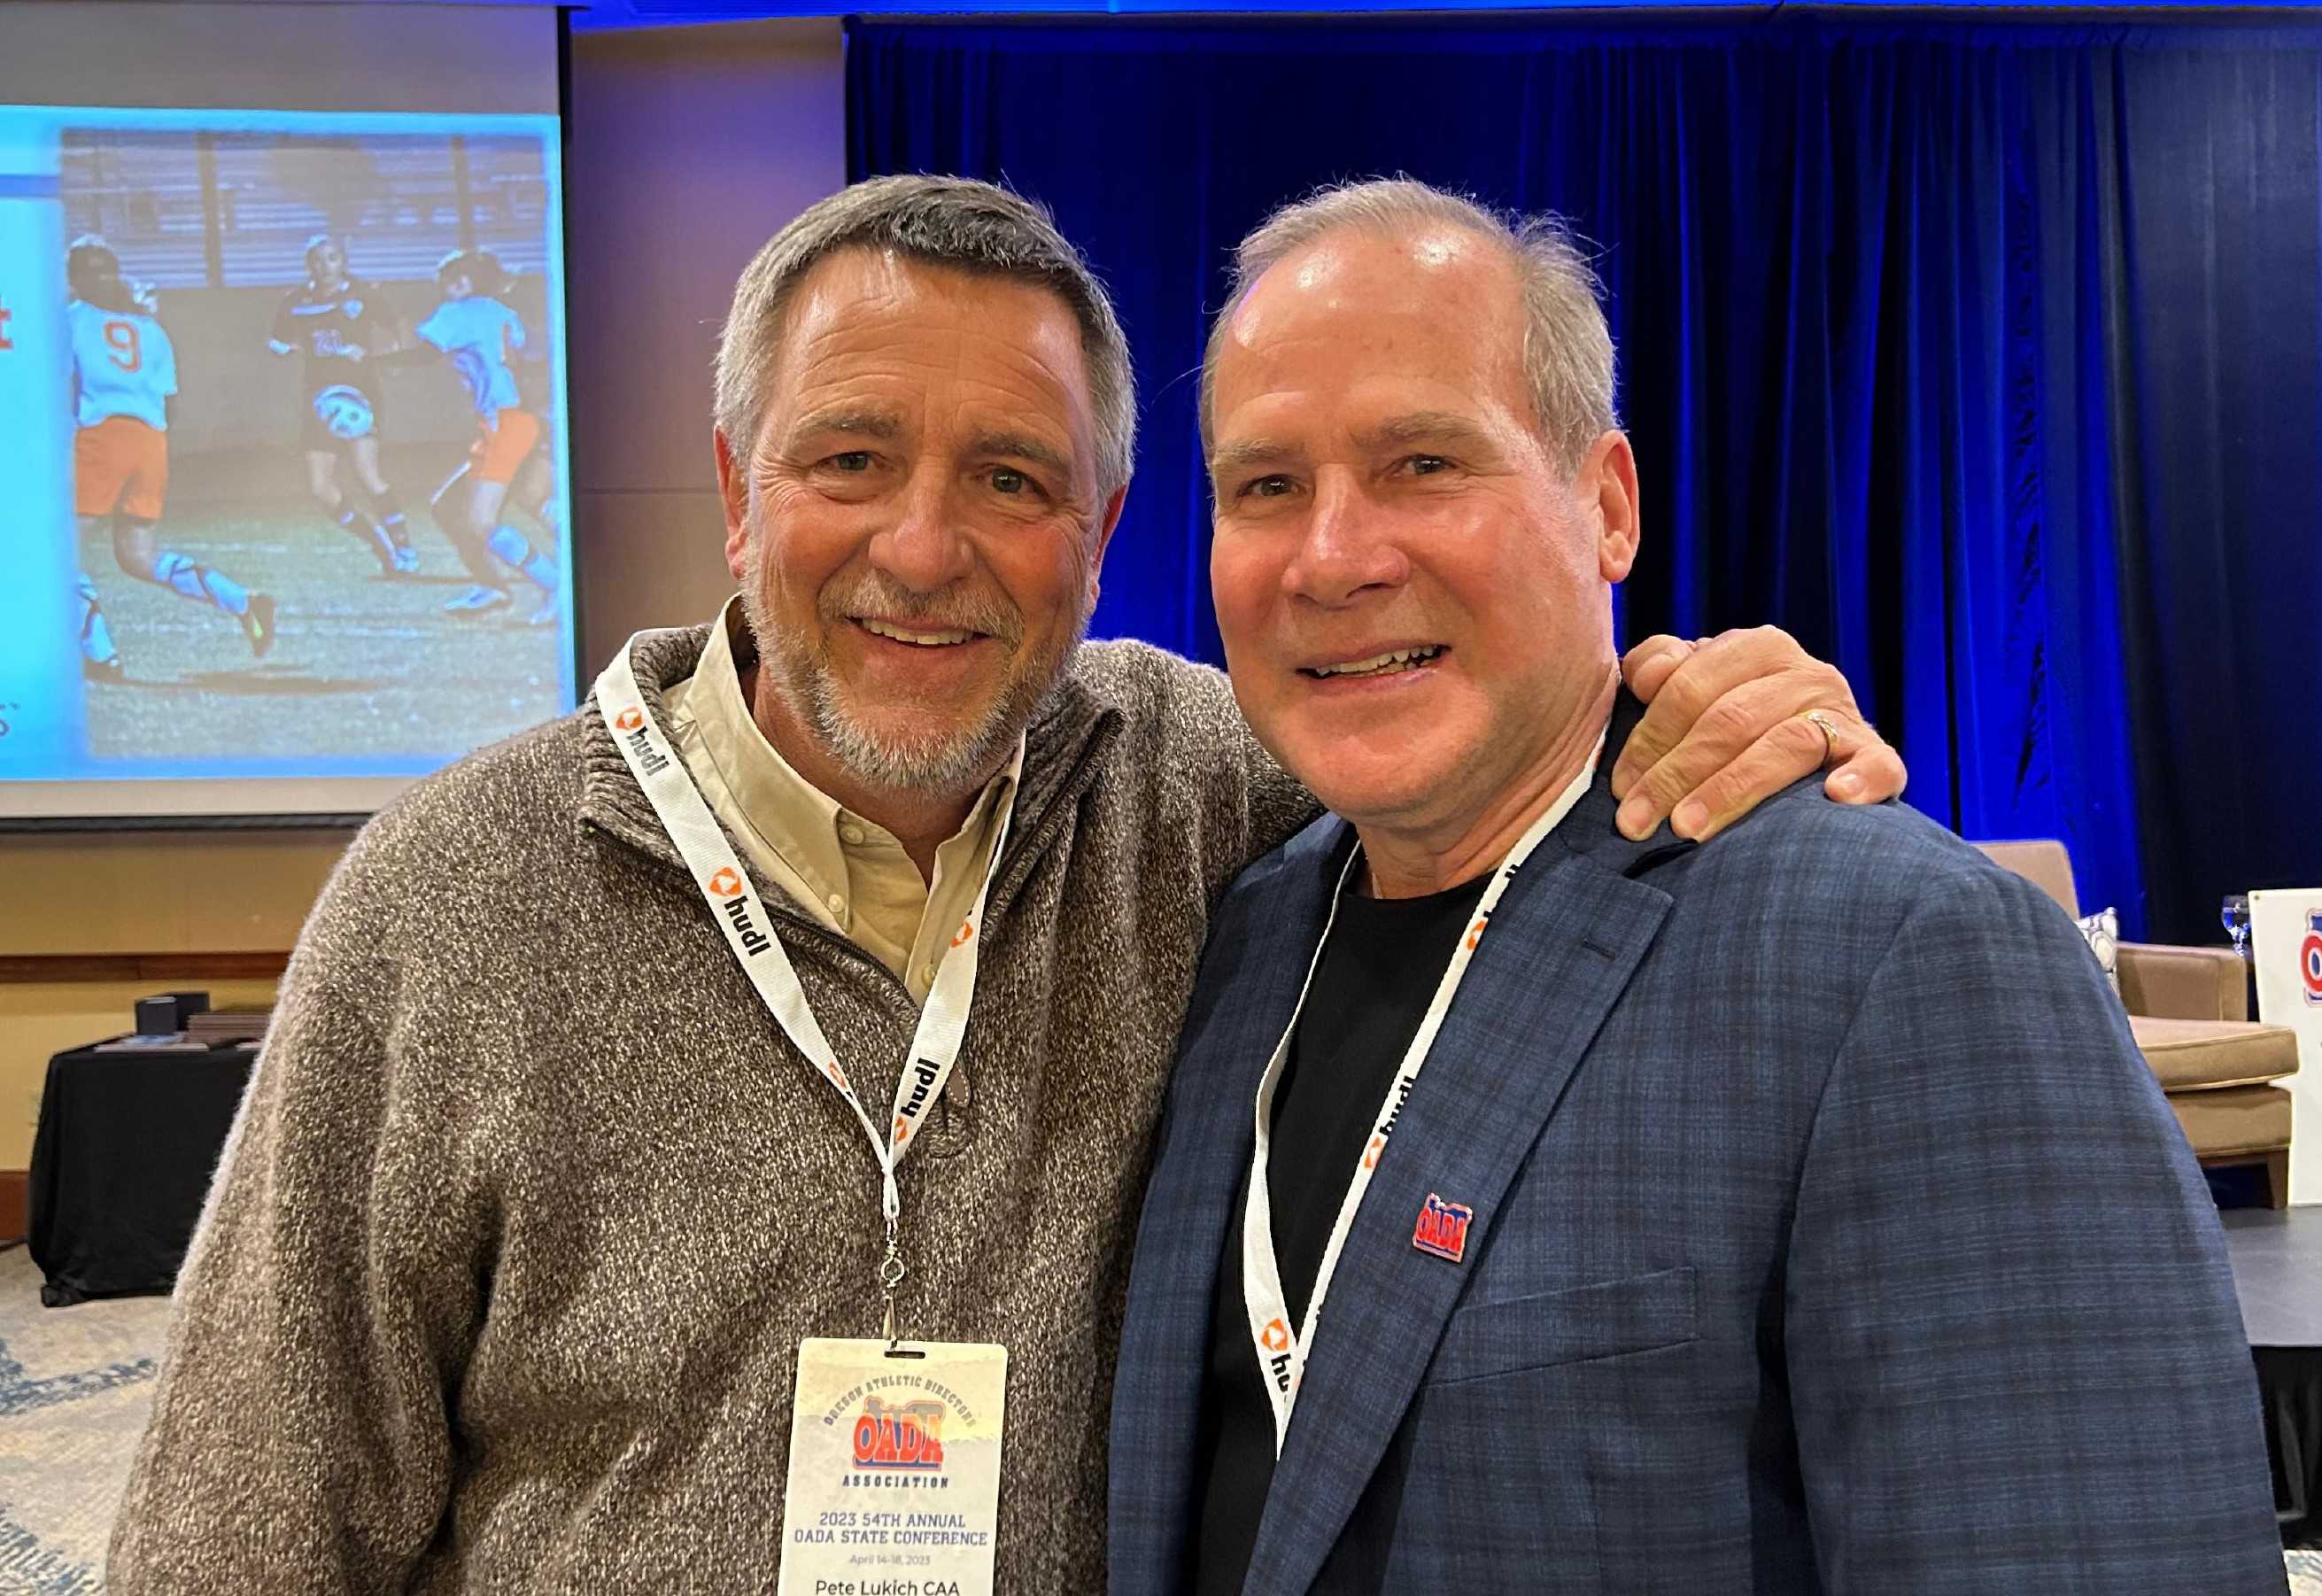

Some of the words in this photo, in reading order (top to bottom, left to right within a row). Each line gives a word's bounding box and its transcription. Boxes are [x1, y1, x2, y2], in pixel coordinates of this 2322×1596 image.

[104, 321, 141, 372] 9
[625, 725, 669, 776] hudl
[724, 895, 770, 956] hudl
[900, 1058, 940, 1118] hudl
[865, 1375, 923, 1393] ATHLETIC
[853, 1413, 944, 1463] OADA
[842, 1474, 948, 1489] ASSOCIATION
[819, 1512, 856, 1526] 2023
[862, 1513, 901, 1527] 54TH
[906, 1515, 966, 1528] ANNUAL
[794, 1530, 835, 1544] OADA
[840, 1530, 888, 1545] STATE
[893, 1530, 987, 1546] CONFERENCE
[849, 1554, 875, 1566] April
[906, 1555, 931, 1565] 2023
[816, 1580, 855, 1595] Pete
[860, 1580, 918, 1596] Lukich
[923, 1582, 960, 1596] CAA
